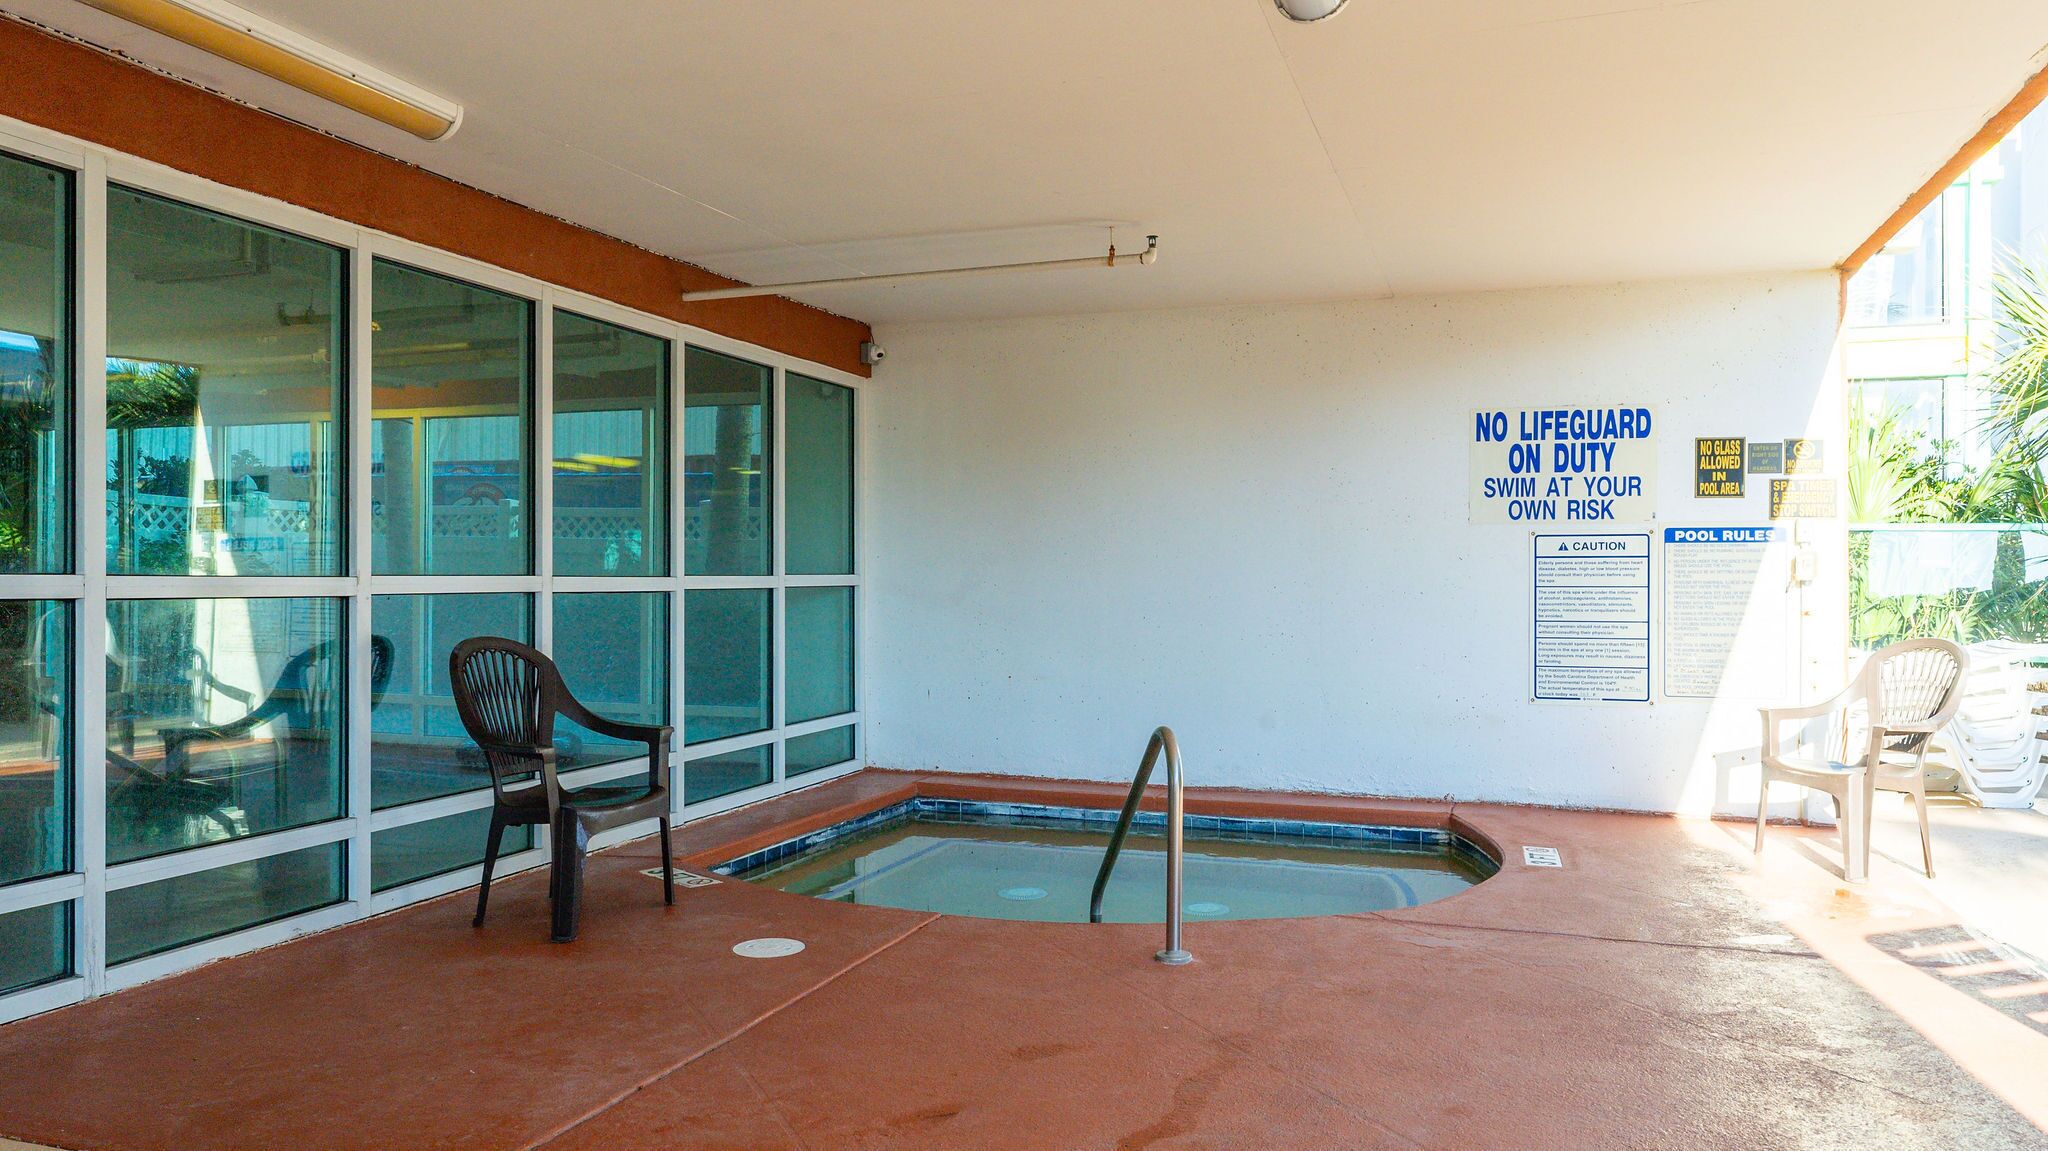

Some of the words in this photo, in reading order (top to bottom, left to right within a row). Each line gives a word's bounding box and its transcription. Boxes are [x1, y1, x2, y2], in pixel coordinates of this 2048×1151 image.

[1476, 412, 1508, 442] NO
[1520, 408, 1652, 441] LIFEGUARD
[1700, 441, 1712, 455] NO
[1714, 440, 1740, 455] GLASS
[1509, 443, 1541, 474] ON
[1554, 442, 1616, 473] DUTY
[1700, 456, 1740, 469] ALLOWED
[1787, 460, 1796, 468] NO
[1713, 472, 1726, 481] IN
[1484, 477, 1536, 498] SWIM
[1546, 477, 1573, 497] AT
[1583, 476, 1642, 497] YOUR
[1700, 483, 1719, 494] POOL
[1720, 482, 1739, 494] AREA
[1773, 481, 1796, 491] SPA
[1773, 492, 1779, 503] &
[1508, 500, 1556, 520] OWN
[1568, 499, 1615, 520] RISK
[1773, 504, 1797, 516] STOP
[1675, 530, 1718, 541] POOL
[1723, 530, 1775, 541] RULES
[1573, 541, 1626, 551] CAUTION
